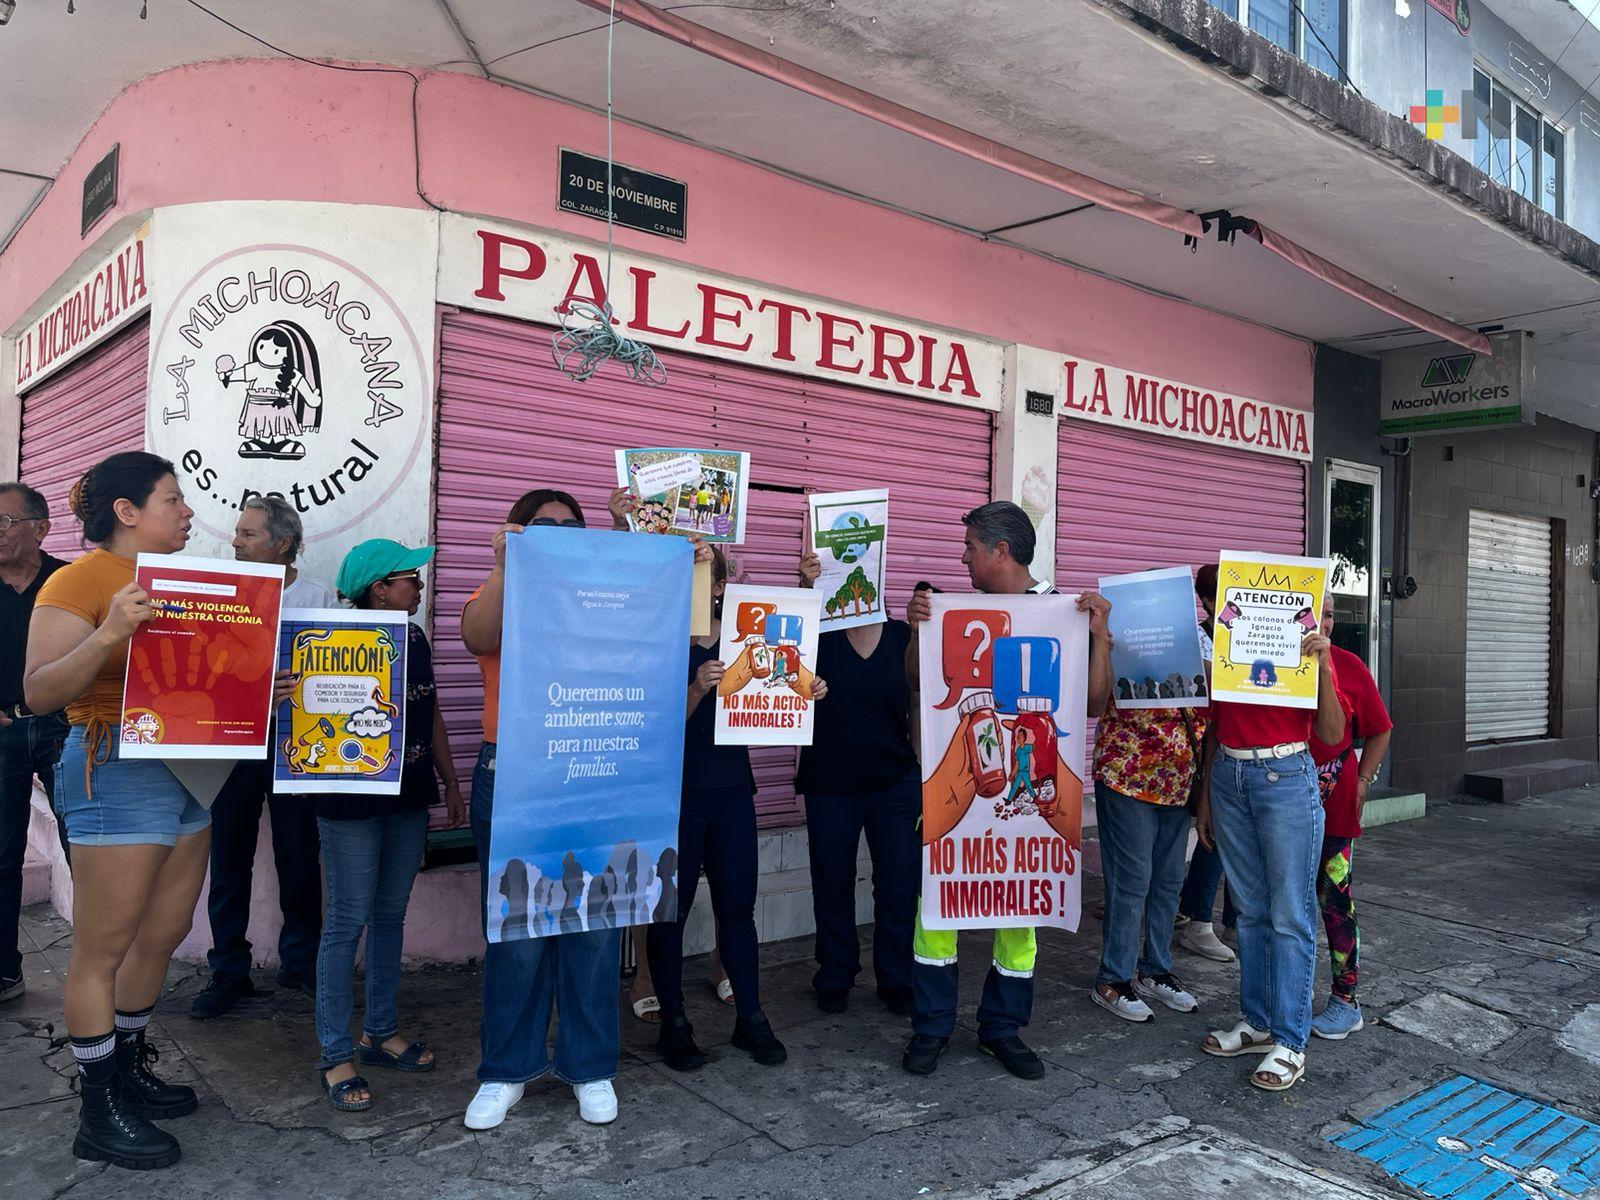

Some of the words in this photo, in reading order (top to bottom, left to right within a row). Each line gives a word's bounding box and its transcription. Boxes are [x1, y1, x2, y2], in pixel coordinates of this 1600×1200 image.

[562, 199, 578, 210] COL.
[569, 174, 583, 188] 20
[587, 178, 604, 193] DE
[607, 184, 677, 214] NOVIEMBRE
[17, 332, 32, 385] LA
[36, 240, 147, 372] MICHOACANA
[475, 229, 982, 398] PALETERIA
[163, 355, 195, 426] LA
[179, 266, 404, 428] MICHOACANA
[1029, 396, 1052, 414] 1680
[1064, 361, 1112, 417] LA
[1123, 374, 1311, 455] MICHOACANA
[1391, 385, 1510, 411] MacroWorkers
[182, 438, 380, 513] es...ntural
[170, 599, 194, 609] MÁS
[196, 602, 250, 614] VIOLENCIA
[1234, 592, 1305, 606] ATENCIÓN
[166, 611, 214, 621] NUESTRA
[216, 614, 263, 625] COLONIA
[1251, 623, 1282, 631] Ignacio
[1124, 626, 1162, 637] Queremos
[1247, 631, 1285, 640] Zaragoza
[1235, 640, 1275, 648] queremos
[1260, 649, 1285, 657] miedo
[300, 643, 384, 678] ¡ATENCIÓN!
[548, 682, 624, 707] Queremos
[626, 687, 645, 701] un
[723, 694, 740, 709] NO
[742, 692, 770, 710] MÁS
[772, 695, 809, 711] ACTOS
[545, 707, 613, 728] ambiente
[613, 710, 645, 728] sano;
[728, 712, 795, 728] INMORALES
[547, 737, 580, 759] para
[582, 735, 639, 753] nuestras
[564, 756, 619, 784] familias.
[929, 836, 954, 875] NO
[962, 827, 1007, 875] MÁS
[1014, 836, 1075, 876] ACTOS
[940, 879, 1053, 919] INMORALES
[1058, 880, 1066, 917] !
